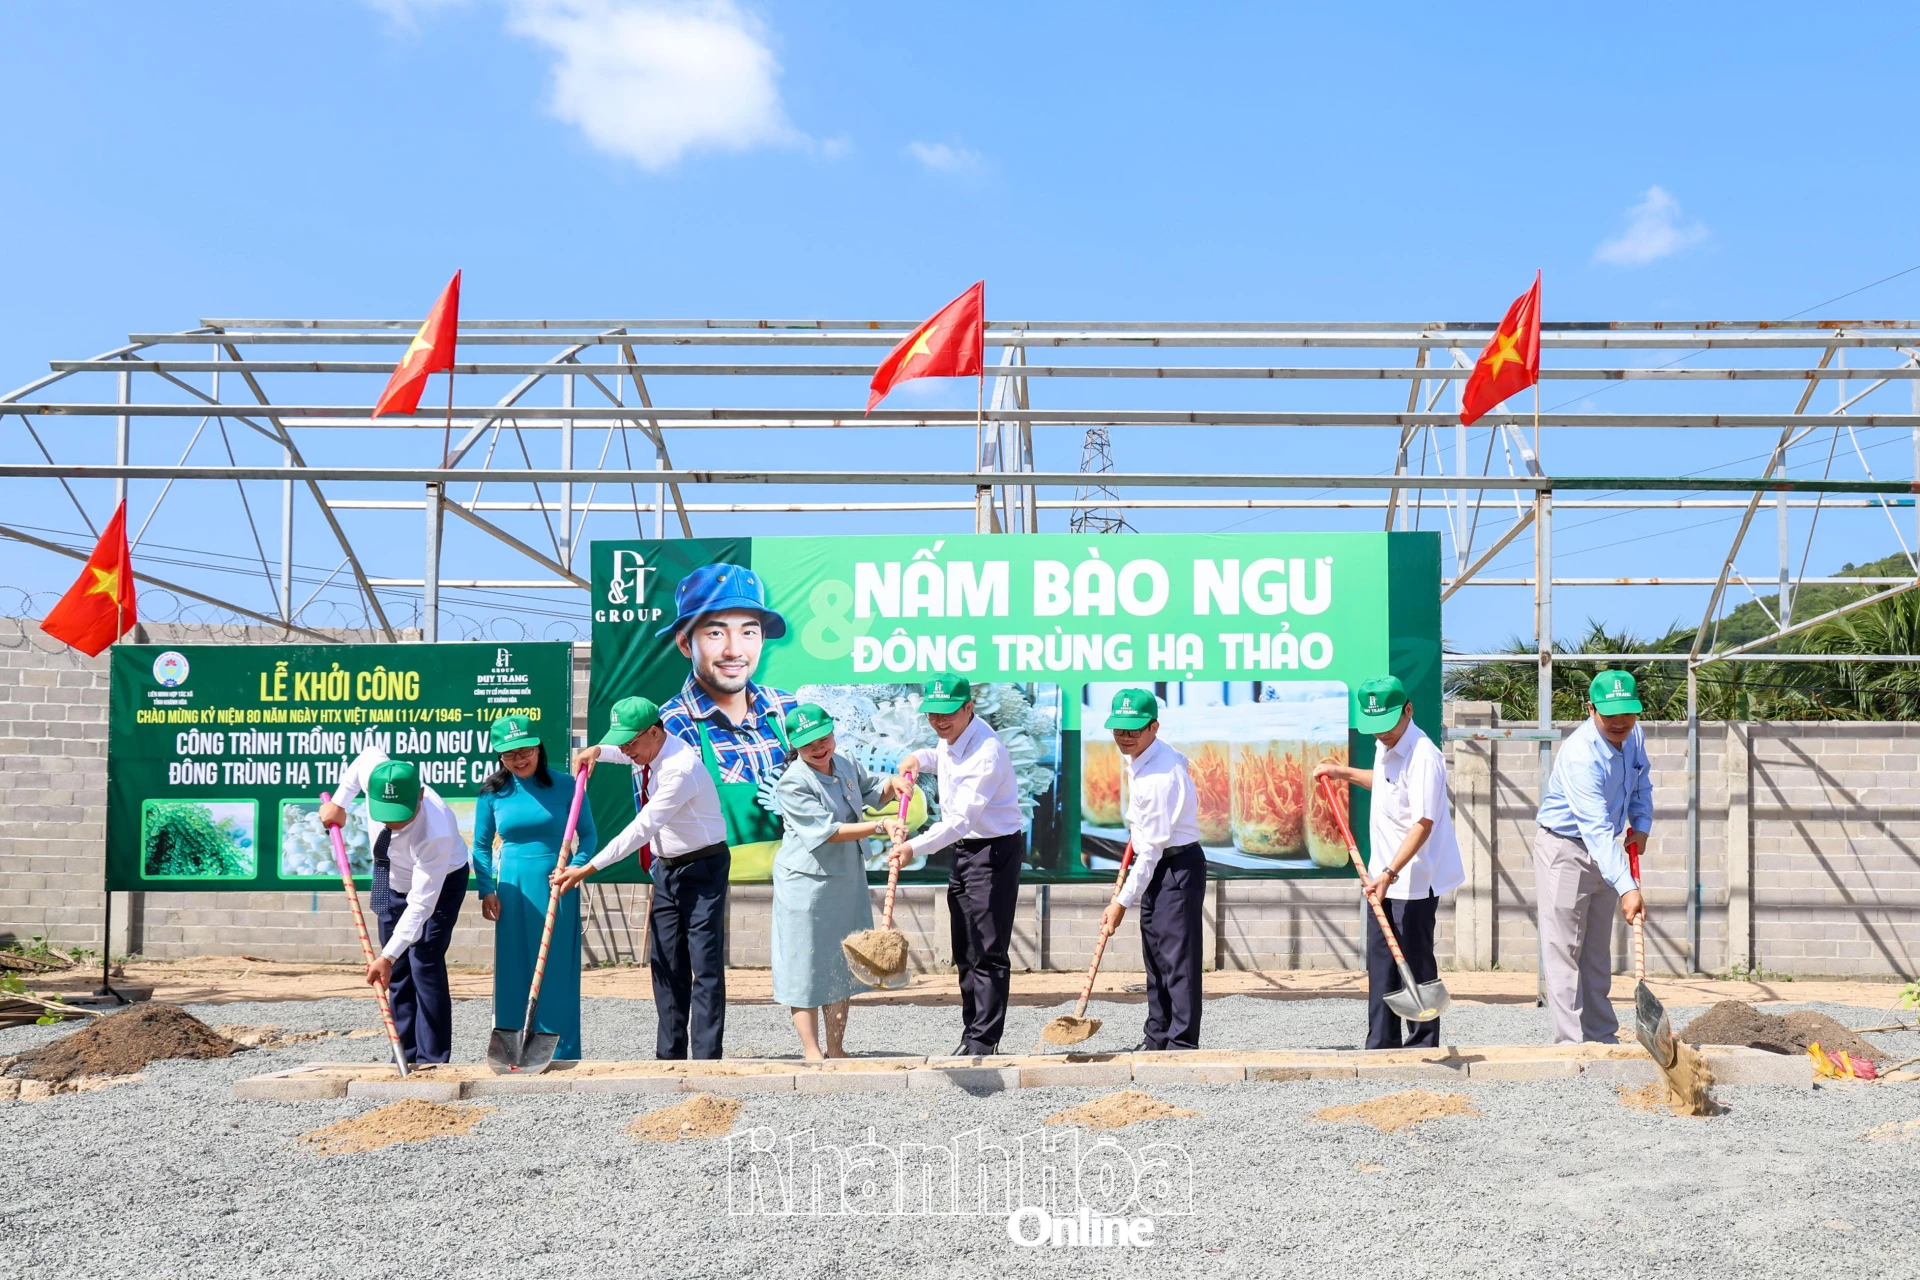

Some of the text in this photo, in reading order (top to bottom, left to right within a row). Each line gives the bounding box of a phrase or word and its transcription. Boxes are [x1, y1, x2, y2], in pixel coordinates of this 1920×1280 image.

[854, 540, 1334, 619] NẤM BÀO NGƯ
[595, 608, 662, 623] GROUP
[850, 621, 1334, 680] ĐÔNG TRÙNG HẠ THẢO
[260, 660, 420, 701] LỄ KHỞI CÔNG
[477, 675, 529, 683] DUY TRANG
[137, 707, 165, 724] CHÀO
[167, 707, 199, 724] MỪNG
[200, 705, 216, 724] KỶ
[217, 708, 245, 726] NIỆM
[246, 709, 261, 724] 80
[263, 708, 287, 723] NĂM
[289, 707, 319, 723] NGÀY
[320, 709, 342, 723] HTX
[344, 707, 368, 725] VIỆT
[369, 709, 394, 723] NAM
[395, 708, 462, 723] (11/4/1946
[176, 727, 225, 755] CÔNG
[228, 727, 283, 755] TRÌNH
[287, 725, 346, 755] TRỒNG
[350, 724, 391, 754] NẤM
[395, 727, 432, 754] BÀO
[436, 729, 474, 754] NGƯ
[168, 758, 218, 785] ĐÔNG
[222, 757, 281, 785] TRÙNG
[285, 761, 311, 789] HẠ
[419, 756, 467, 788] NGHỆ
